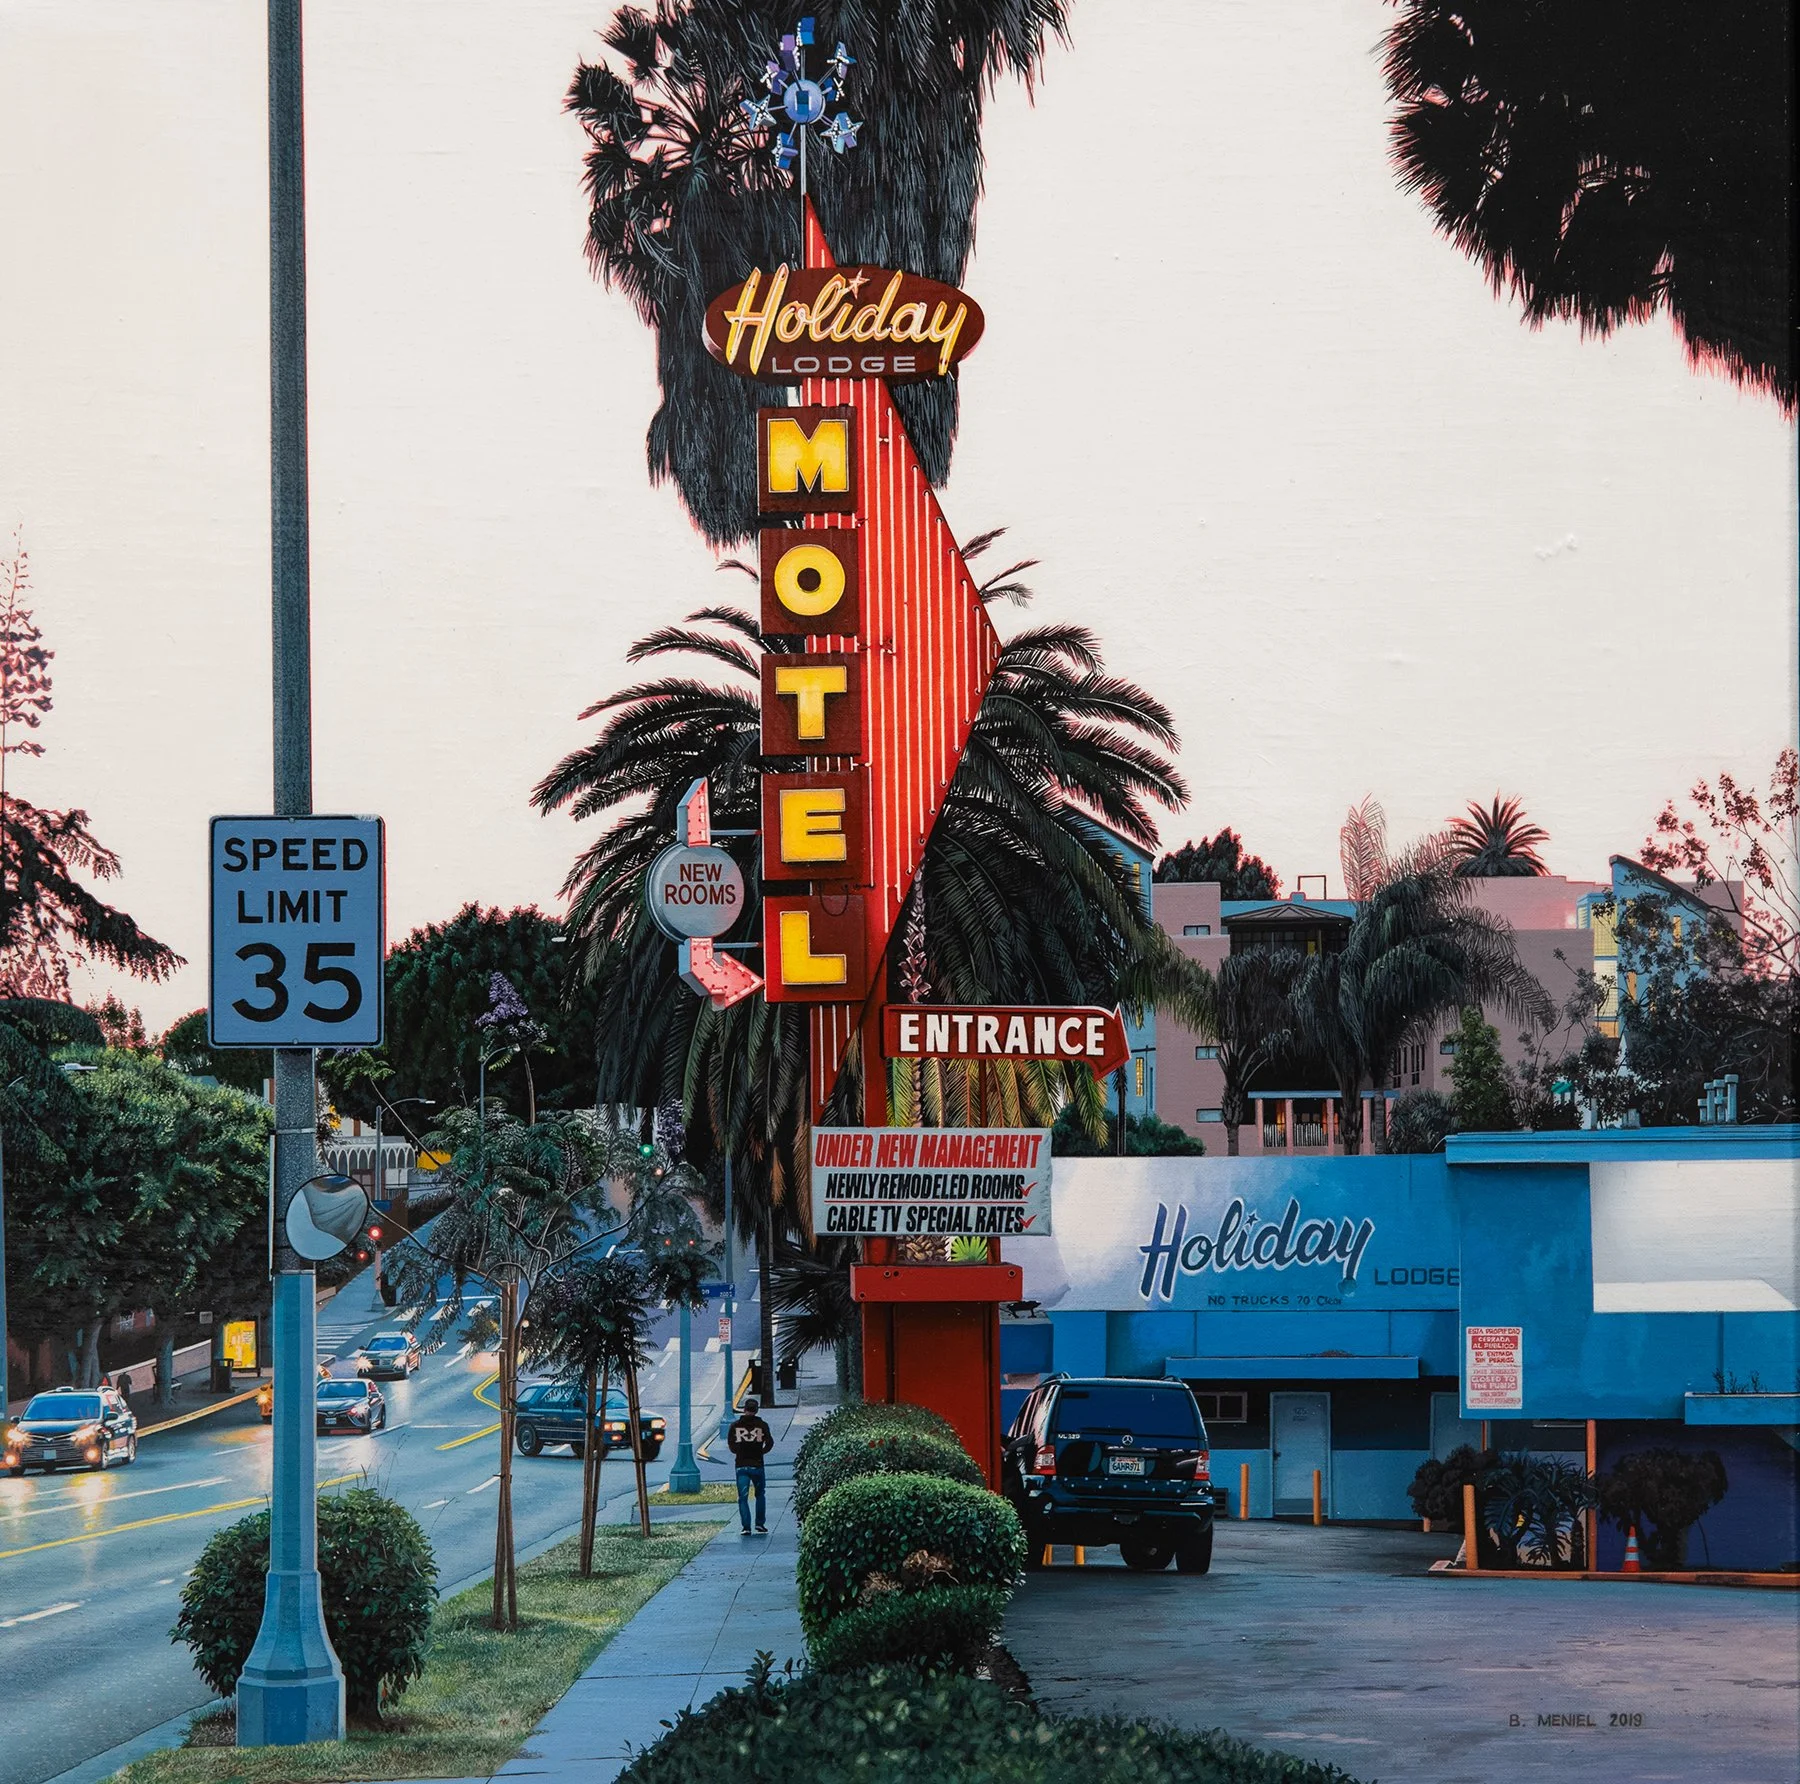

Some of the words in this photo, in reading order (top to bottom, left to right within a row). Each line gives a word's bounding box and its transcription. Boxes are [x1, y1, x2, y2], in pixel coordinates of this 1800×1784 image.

[724, 262, 968, 376] Holiday
[772, 356, 917, 374] LODGE
[767, 418, 848, 985] MOTEL
[222, 837, 369, 872] SPEED
[679, 863, 723, 882] NEW
[237, 889, 348, 924] LIMIT
[665, 885, 736, 905] ROOMS
[231, 942, 363, 1024] 35
[900, 1013, 1105, 1056] ENTRANCE
[815, 1133, 874, 1168] UNDER
[876, 1134, 919, 1168] NEW
[918, 1134, 1043, 1169] MANAGEMENT
[825, 1173, 879, 1199] NEWLY
[878, 1173, 969, 1200] REMODELED
[970, 1174, 1025, 1200] ROOMS
[826, 1205, 878, 1232] CABLE
[880, 1205, 902, 1232] TV
[905, 1205, 973, 1233] SPECIAL
[974, 1206, 1025, 1233] RATES
[1139, 1197, 1375, 1301] Holiday
[1374, 1267, 1460, 1287] LODGE
[1207, 1295, 1226, 1306] NO
[1232, 1295, 1290, 1305] TRUCKS
[1509, 1713, 1526, 1727] B.
[1537, 1713, 1597, 1727] MENIEL
[1610, 1713, 1643, 1728] 2019
